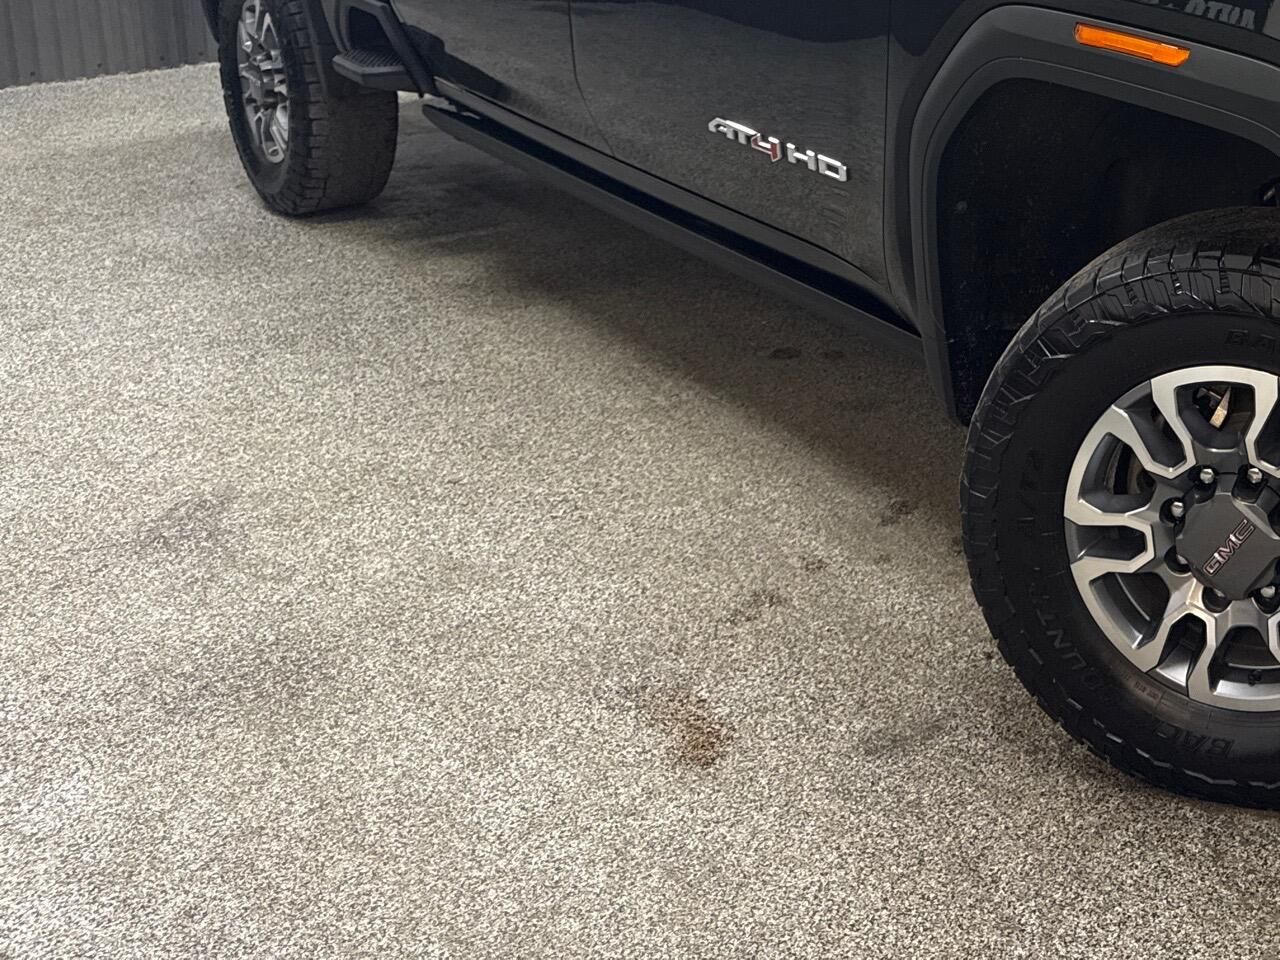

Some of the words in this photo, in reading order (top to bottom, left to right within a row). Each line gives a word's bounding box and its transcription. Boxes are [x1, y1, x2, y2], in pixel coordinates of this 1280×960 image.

[708, 117, 782, 162] AT4
[786, 142, 848, 182] HD
[1203, 519, 1255, 576] GMC
